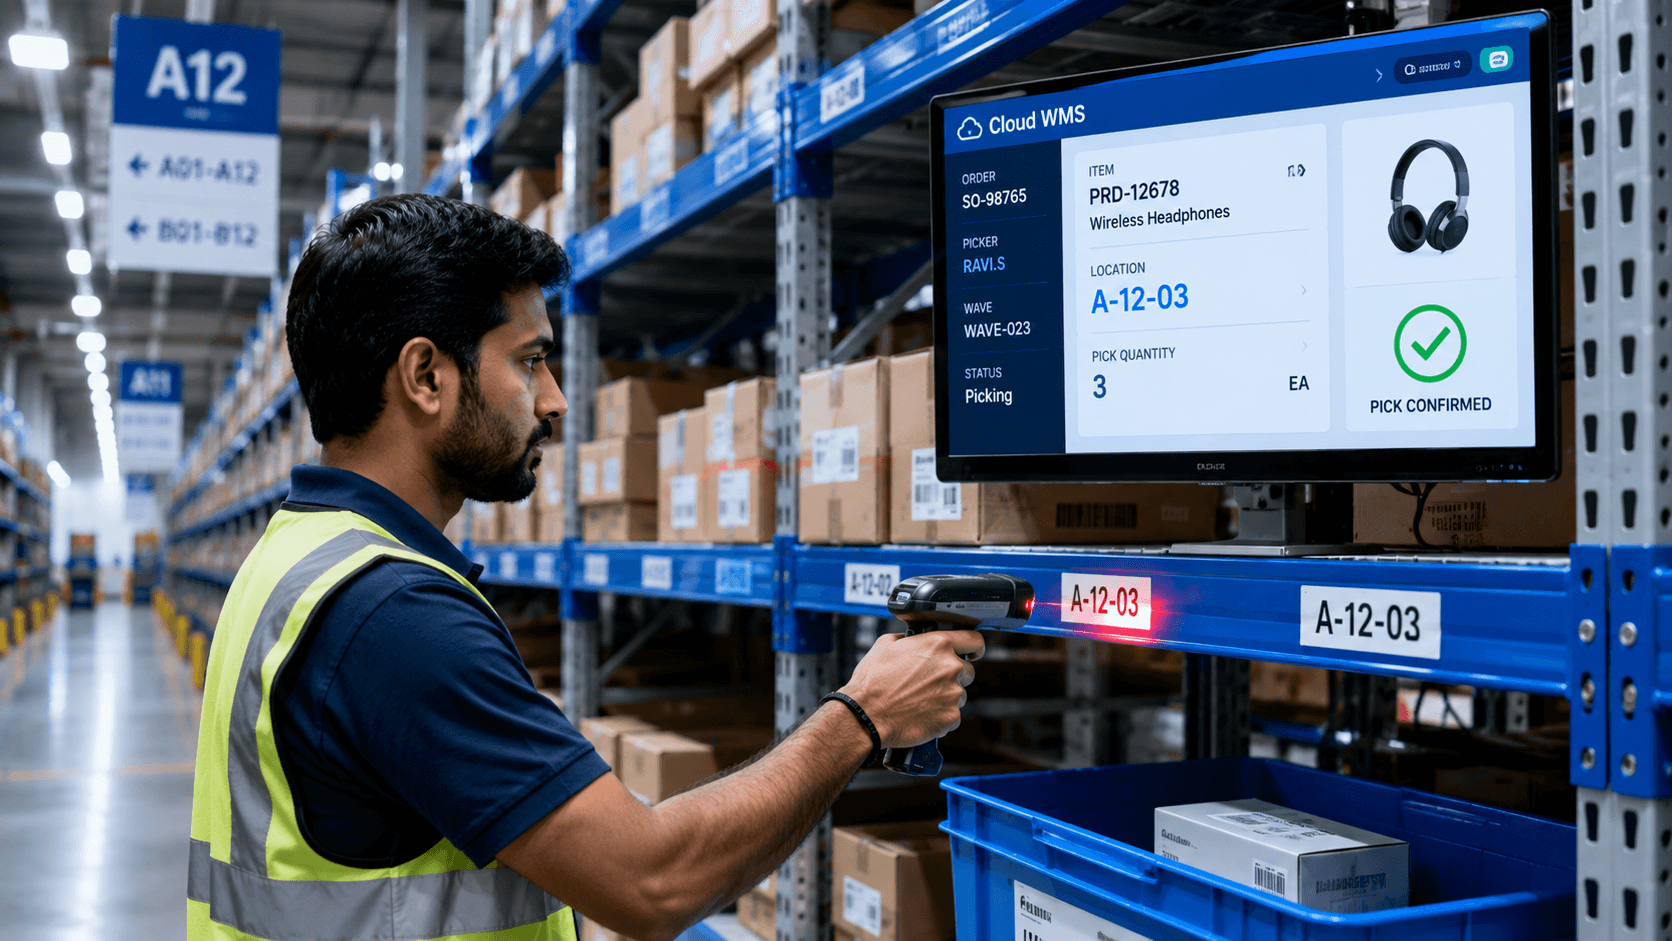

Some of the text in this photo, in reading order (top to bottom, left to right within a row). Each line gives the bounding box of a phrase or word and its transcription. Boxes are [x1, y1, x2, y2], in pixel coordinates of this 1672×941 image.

[146, 45, 247, 105] A12
[989, 104, 1085, 134] Cloud WMS
[158, 155, 261, 186] A01-A12
[961, 170, 996, 185] ORDER
[1088, 164, 1115, 177] ITEM
[962, 188, 1027, 209] SO-98765
[1089, 179, 1180, 205] PRD-12678
[1090, 206, 1231, 230] Wireless Headphones
[158, 218, 259, 248] B01-B12
[962, 235, 998, 250] PICKER
[963, 256, 1006, 274] RAVI.S
[1090, 262, 1146, 277] LOCATION
[963, 301, 993, 315] WAVE
[1091, 283, 1189, 314] A-12-03
[964, 321, 1031, 338] WAVE-023
[1092, 347, 1176, 362] PICK QUANTITY
[965, 366, 1002, 380] STATUS
[1092, 374, 1107, 399] 3
[1289, 375, 1310, 391] EA
[965, 388, 1013, 406] Picking
[1370, 397, 1492, 413] PICK CONFIRMED
[850, 571, 893, 597] A-12-02
[1070, 584, 1139, 617] A-12-03
[1314, 599, 1421, 642] A-12-03
